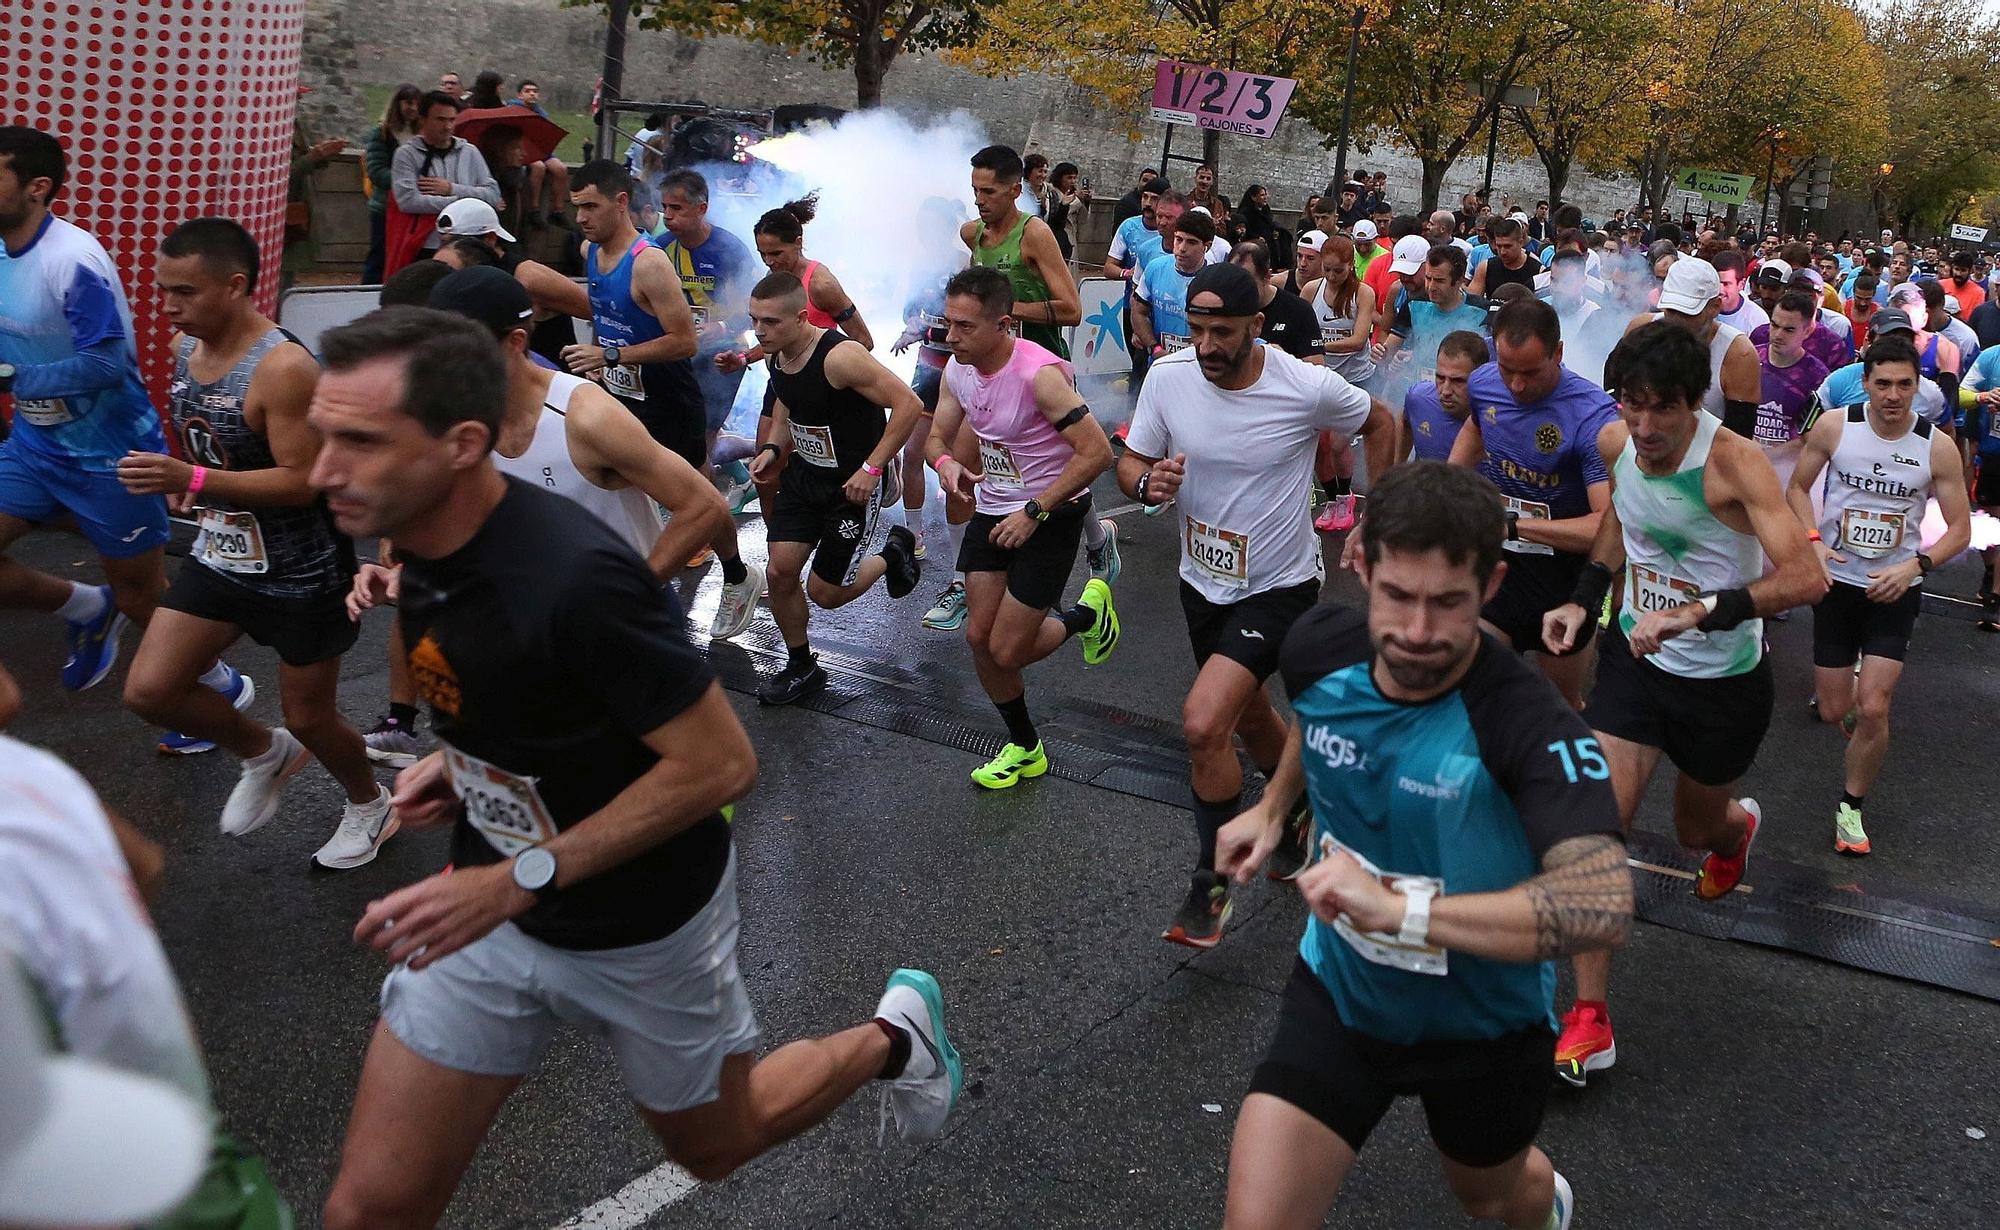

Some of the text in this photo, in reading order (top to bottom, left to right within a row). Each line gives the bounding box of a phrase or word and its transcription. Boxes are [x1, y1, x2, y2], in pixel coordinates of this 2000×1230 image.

[1170, 64, 1276, 121] 1/2/3
[1199, 116, 1253, 134] CAJONES
[1684, 171, 1698, 190] 4
[1698, 182, 1740, 197] CAJÓN
[1955, 225, 1962, 235] 5
[1852, 525, 1893, 545] 21274
[1193, 538, 1235, 571] 21423
[1305, 722, 1357, 769] utgs
[1546, 736, 1610, 784] 15
